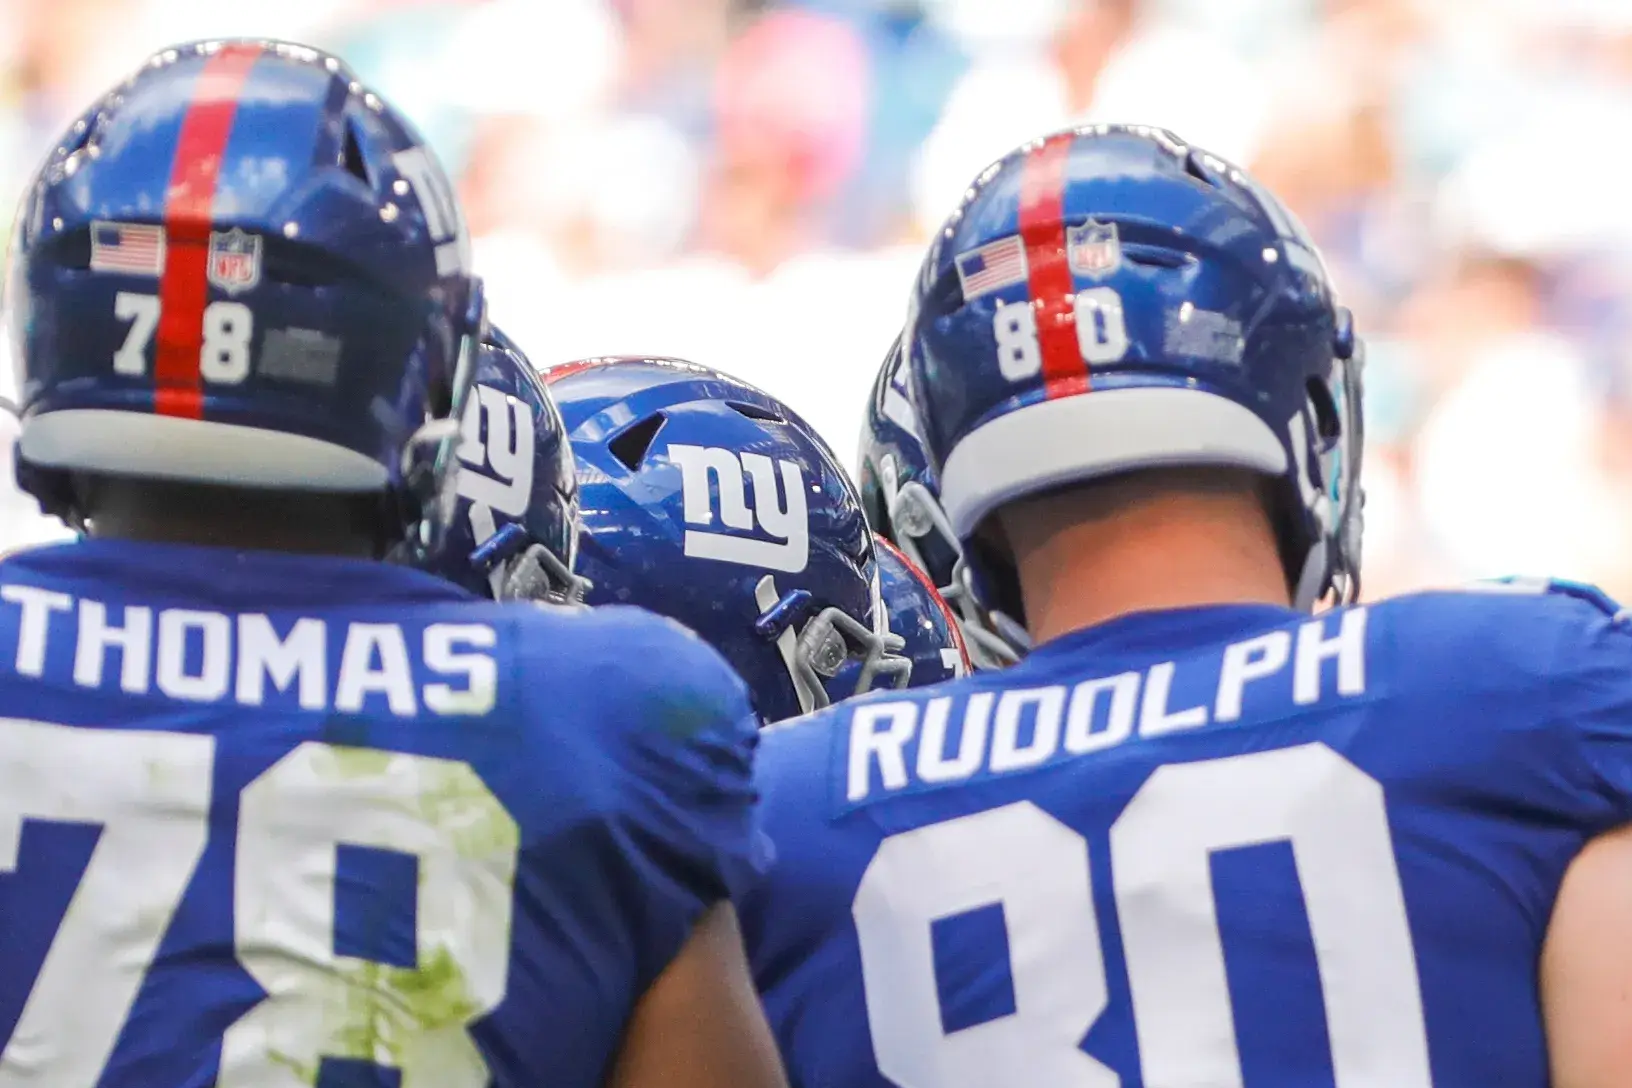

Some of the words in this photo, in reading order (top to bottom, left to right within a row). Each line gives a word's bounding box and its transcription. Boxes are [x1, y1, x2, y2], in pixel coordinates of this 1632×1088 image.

[667, 443, 809, 574] ny
[0, 585, 498, 716] THOMAS
[847, 608, 1368, 801] RUDOLPH
